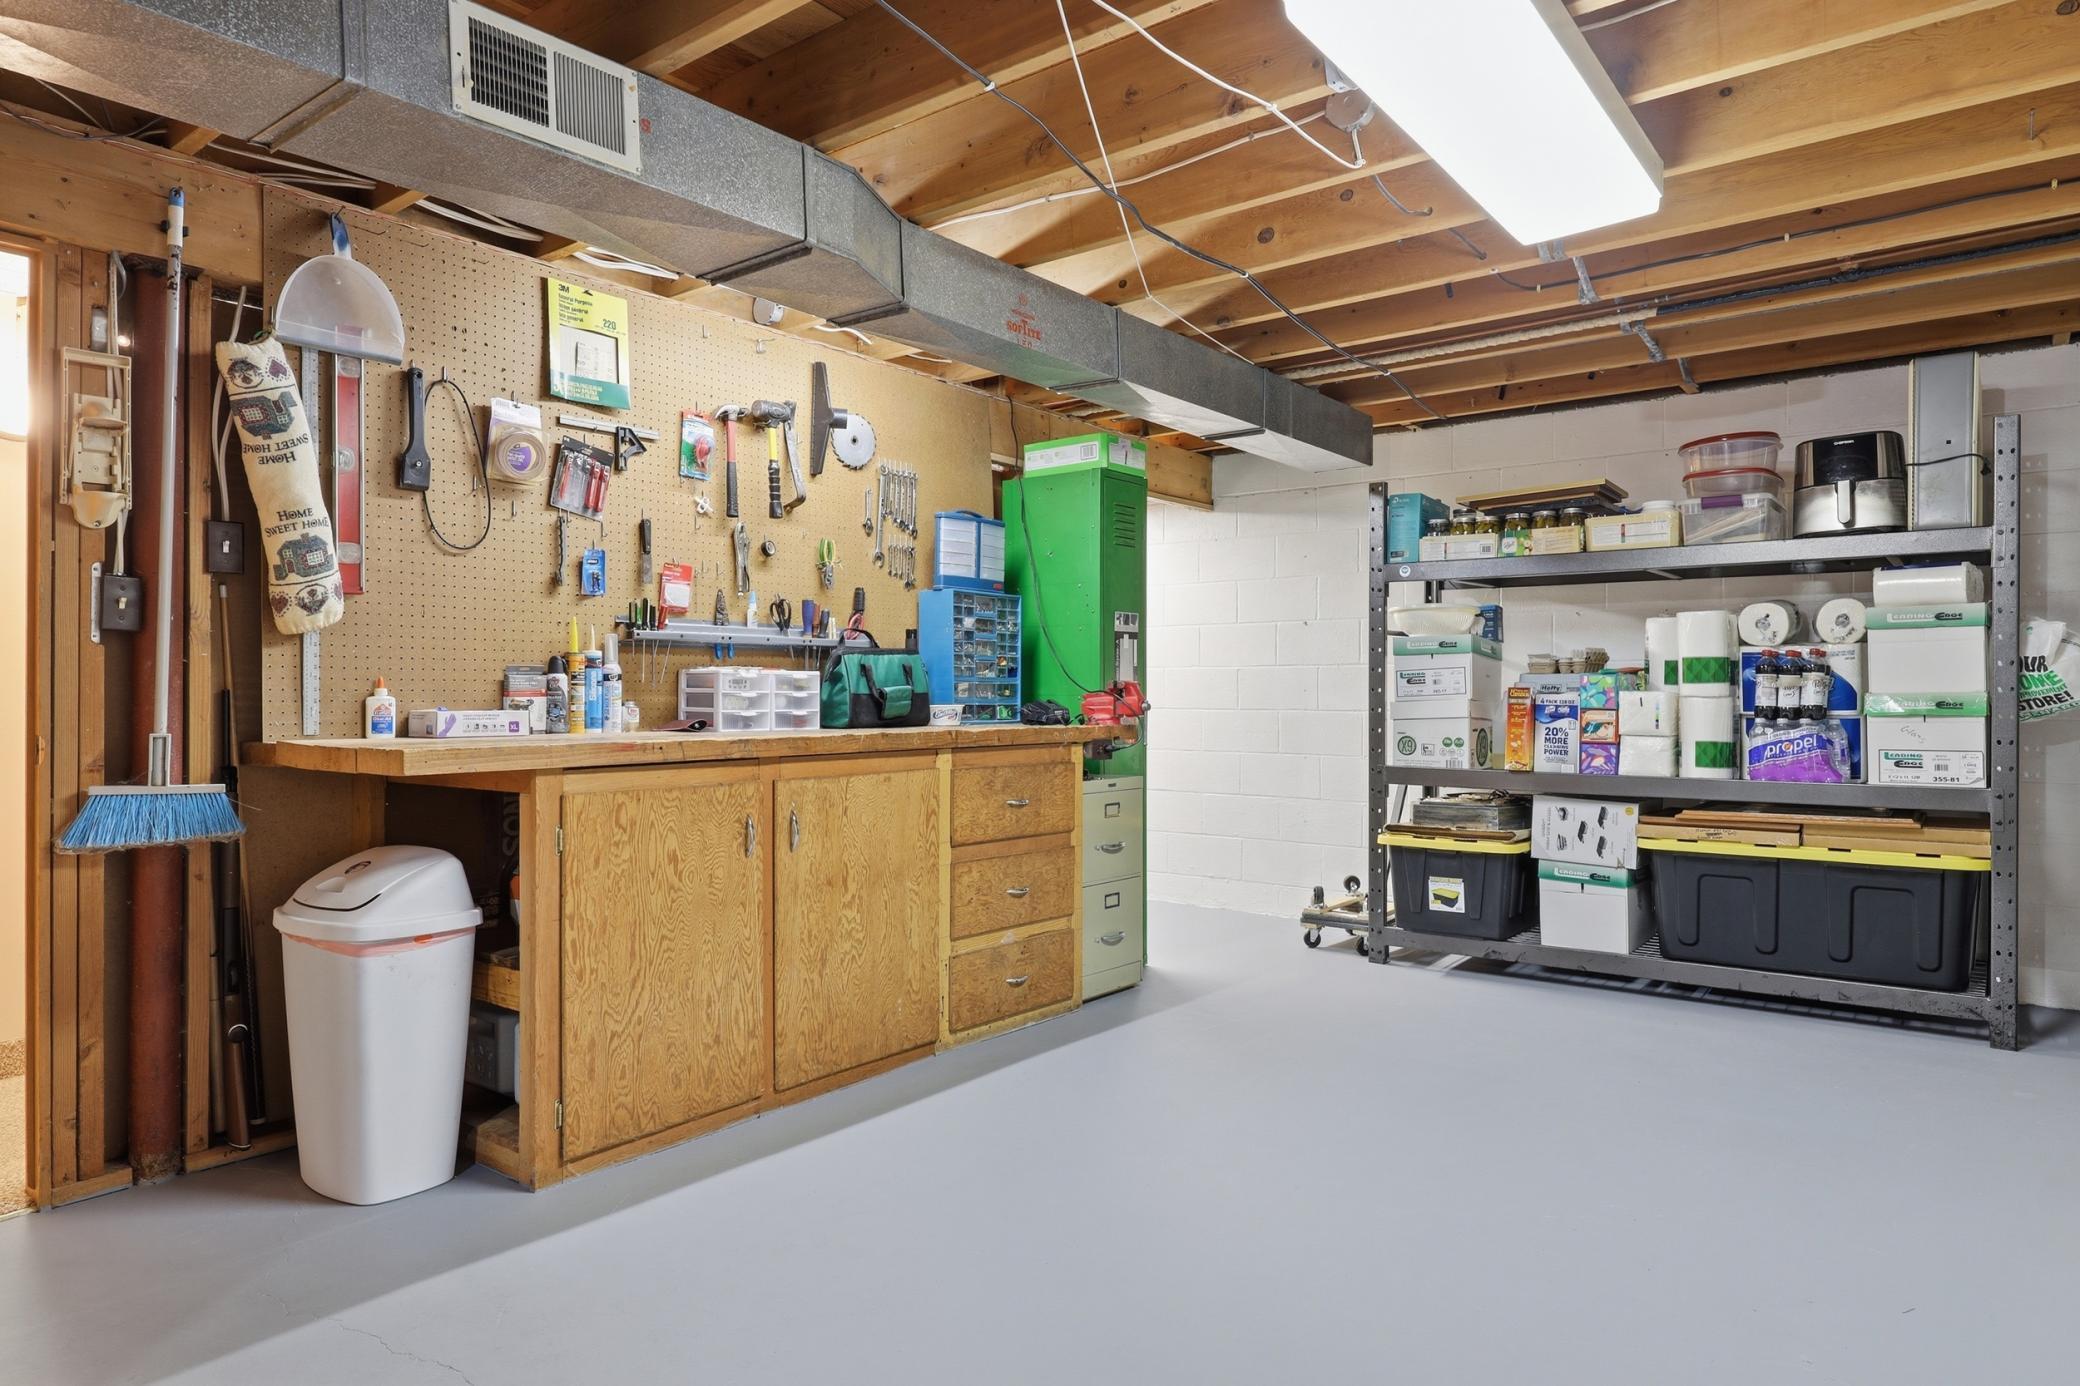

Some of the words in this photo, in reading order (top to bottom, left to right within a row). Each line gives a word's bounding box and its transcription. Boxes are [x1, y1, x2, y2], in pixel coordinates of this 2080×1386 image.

[558, 284, 570, 293] 3M
[602, 319, 616, 330] 220
[242, 443, 272, 453] HOME
[274, 433, 309, 451] SWEET
[257, 451, 296, 465] HOME
[276, 508, 314, 521] HOME
[264, 522, 299, 538] SWEET
[302, 517, 330, 529] HOME
[1545, 727, 1569, 737] 20%
[1401, 740, 1413, 752] X9
[1765, 735, 1817, 758] propel
[1884, 752, 1923, 760] LEADING
